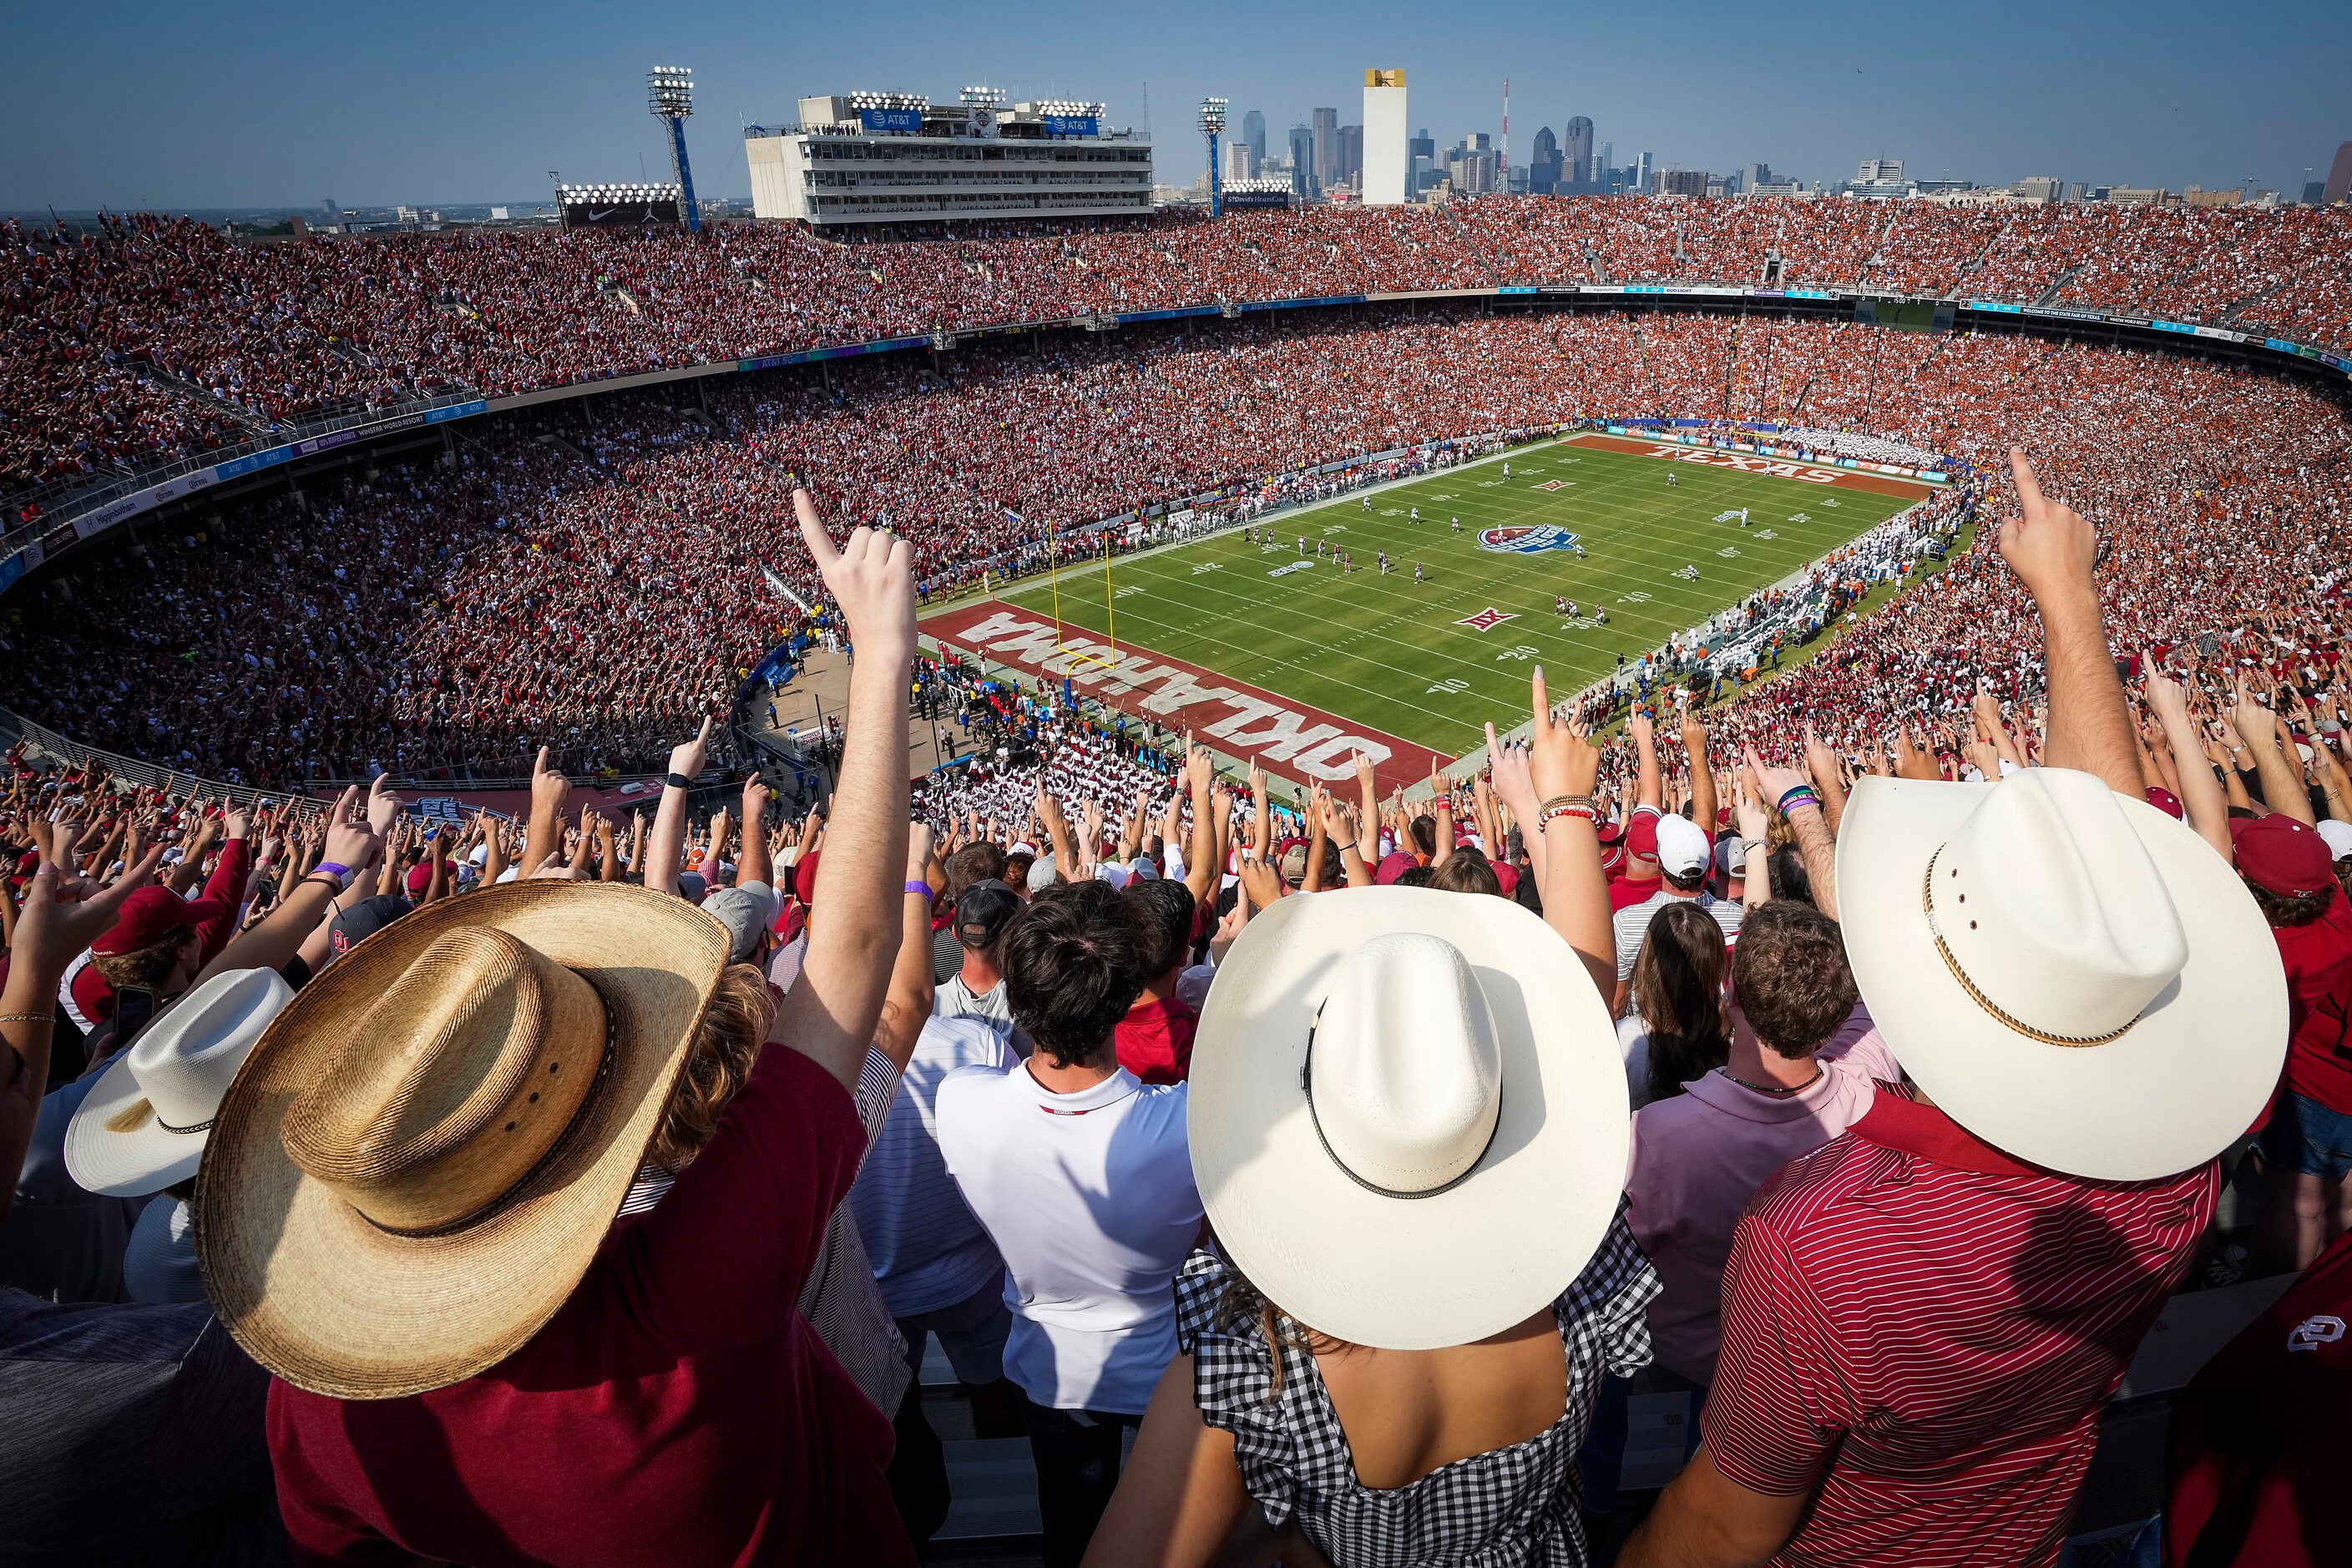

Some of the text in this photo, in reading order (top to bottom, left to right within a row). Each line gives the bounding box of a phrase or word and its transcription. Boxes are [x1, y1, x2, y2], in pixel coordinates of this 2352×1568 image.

[888, 114, 910, 126] AT&T
[1068, 120, 1087, 130] AT&T
[1961, 299, 1971, 308] 23
[1004, 326, 1020, 335] 15:00
[761, 357, 781, 368] AT&T
[469, 403, 483, 412] AT&T
[432, 411, 446, 420] AT&T
[358, 415, 424, 437] WINSTAR WORLD RESORT
[266, 451, 281, 462] AT&T
[228, 463, 243, 474] AT&T
[1646, 445, 1847, 483] TEXAS
[189, 477, 209, 489] Corona
[155, 488, 175, 502] Corona
[96, 501, 136, 526] Higginbotham
[1624, 591, 1652, 603] 40
[1503, 645, 1540, 660] 20
[1433, 678, 1470, 694] 10
[956, 610, 1393, 782] OKLAHOMA
[801, 736, 826, 746] SCHOONE
[332, 928, 349, 953] OU
[2286, 1314, 2347, 1353] OU
